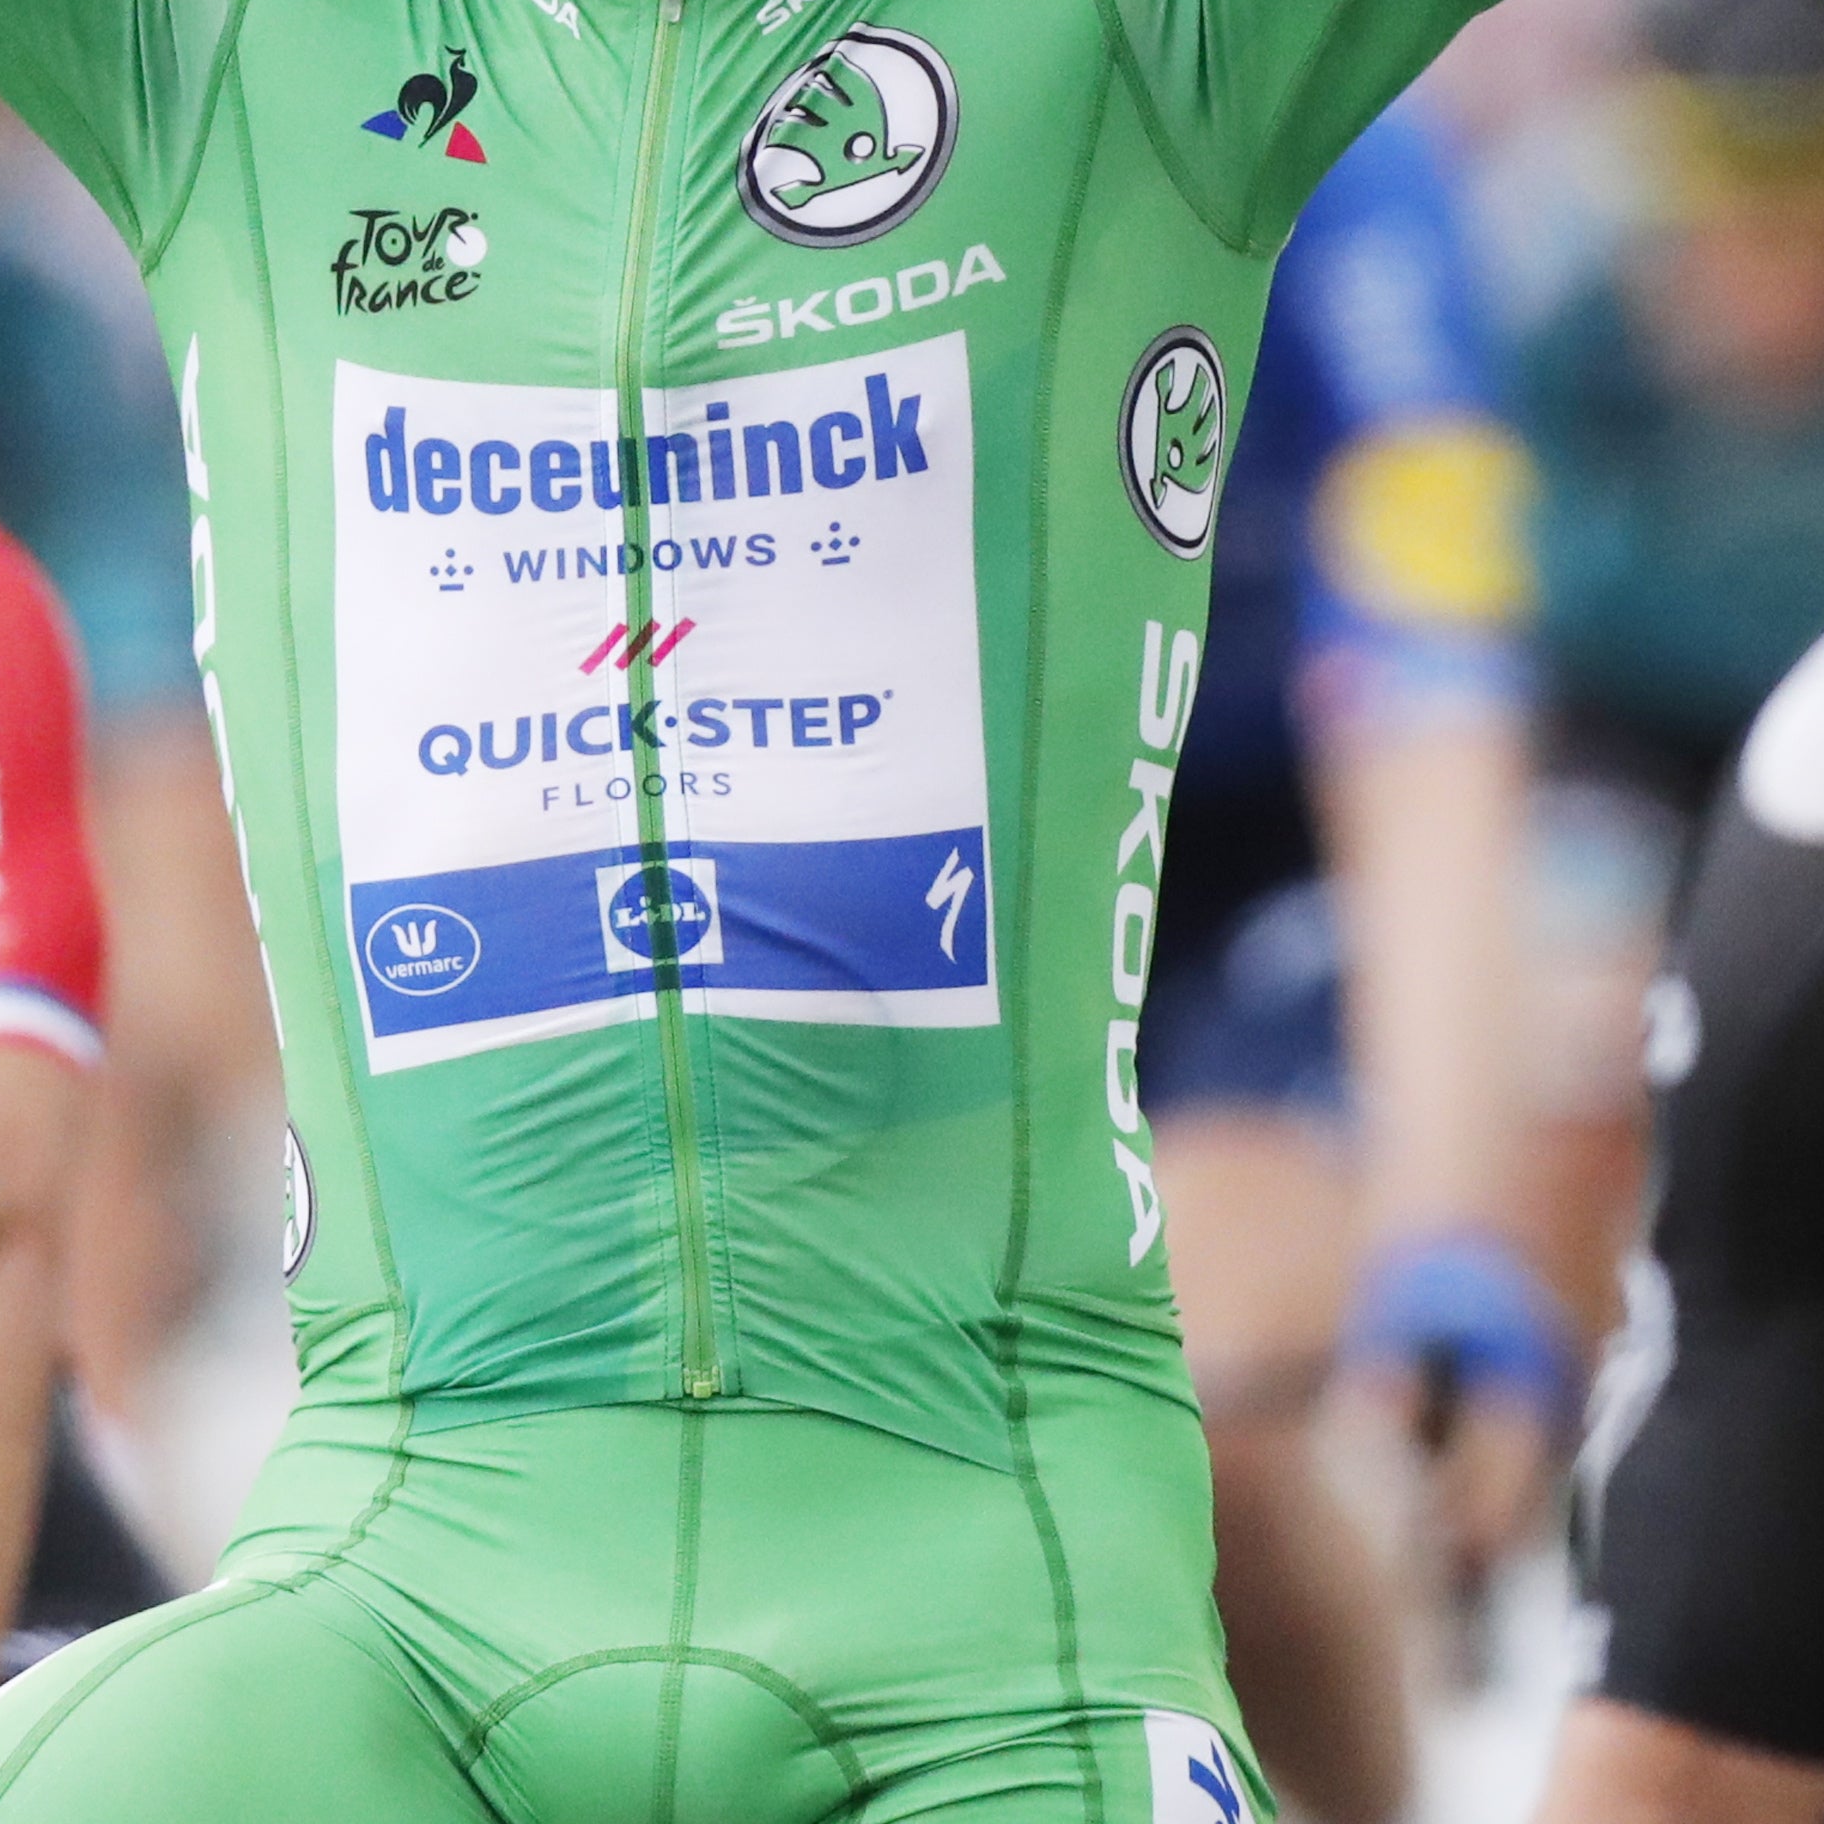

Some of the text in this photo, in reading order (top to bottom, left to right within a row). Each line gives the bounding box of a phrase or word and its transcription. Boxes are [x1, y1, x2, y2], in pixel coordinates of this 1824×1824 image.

[422, 251, 446, 272] de
[716, 242, 1007, 352] ŠKODA
[365, 372, 929, 517] deceuninck
[503, 532, 778, 584] WINDOWS
[542, 771, 733, 812] FLOORS
[384, 955, 465, 980] vermarc
